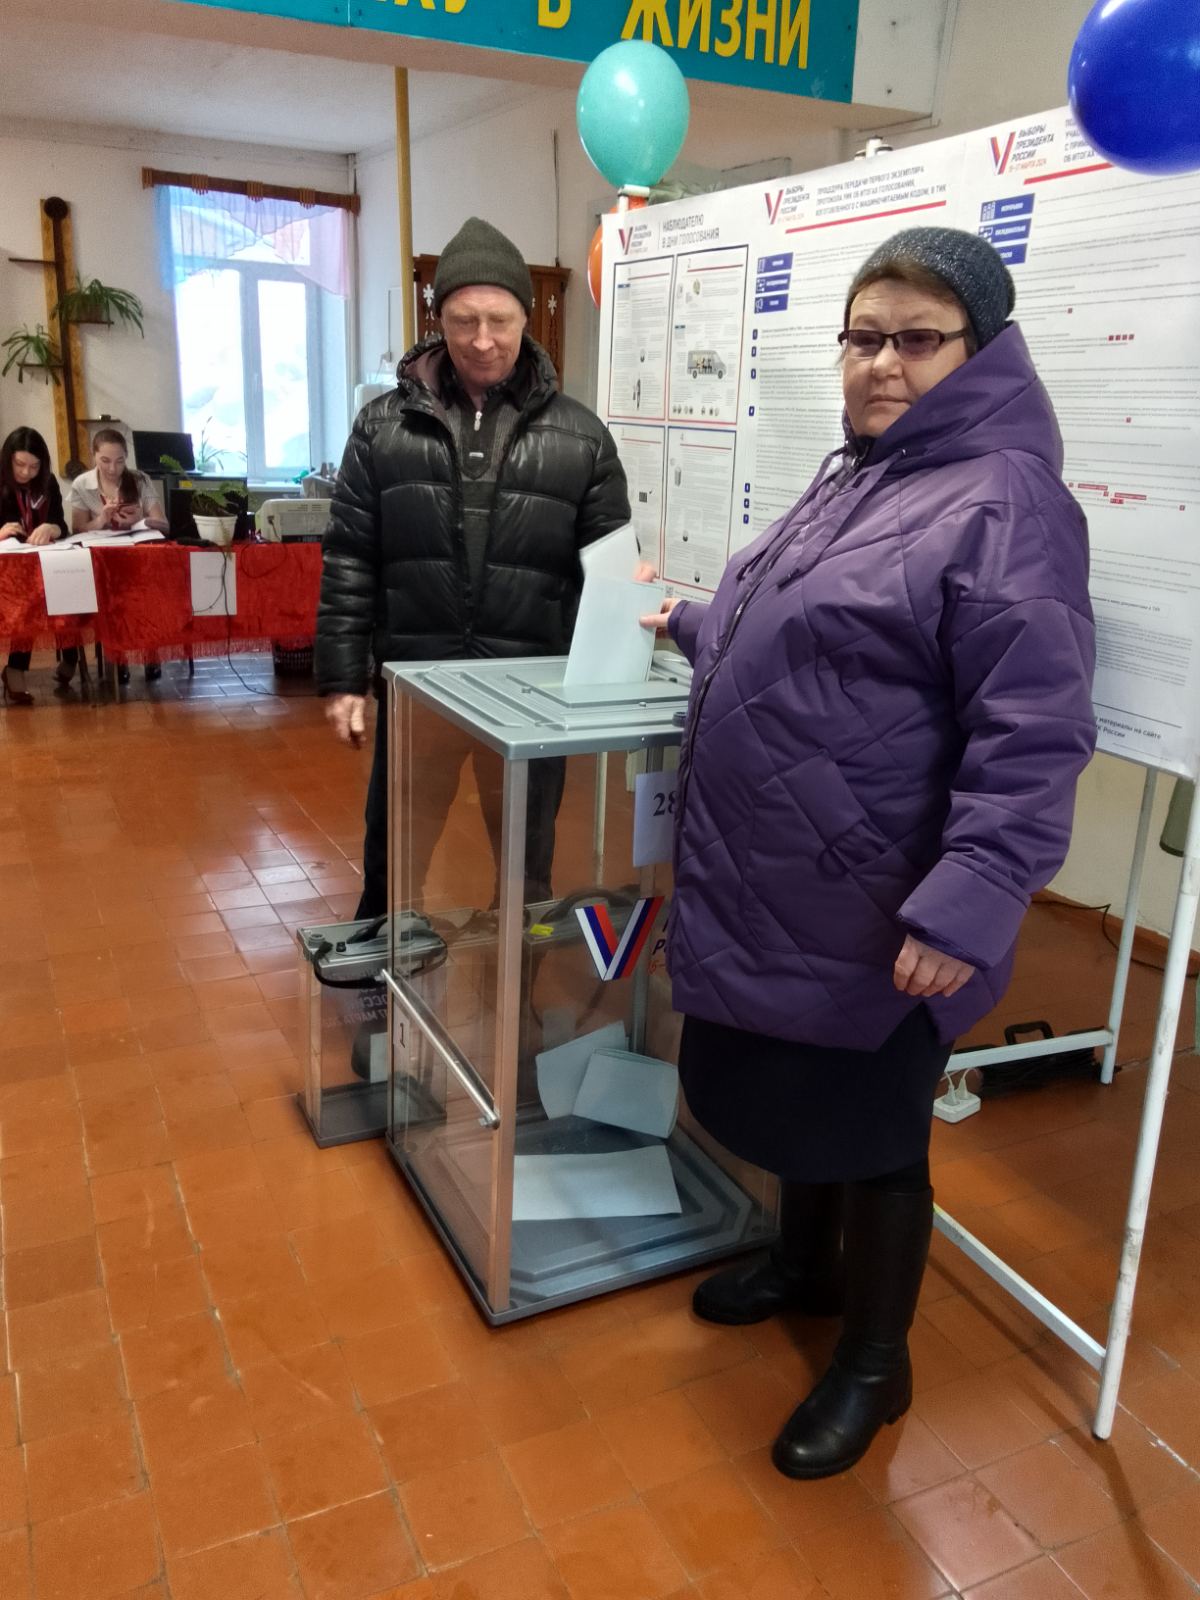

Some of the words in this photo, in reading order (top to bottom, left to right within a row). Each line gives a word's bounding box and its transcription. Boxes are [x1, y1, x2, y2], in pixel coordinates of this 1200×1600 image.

[621, 0, 811, 69] ЖИЗНИ
[1011, 149, 1037, 162] РОССИИ
[662, 213, 705, 232] НАБЛЮДАТЕЛЮ
[679, 227, 720, 246] ГОЛОСОВАНИЯ
